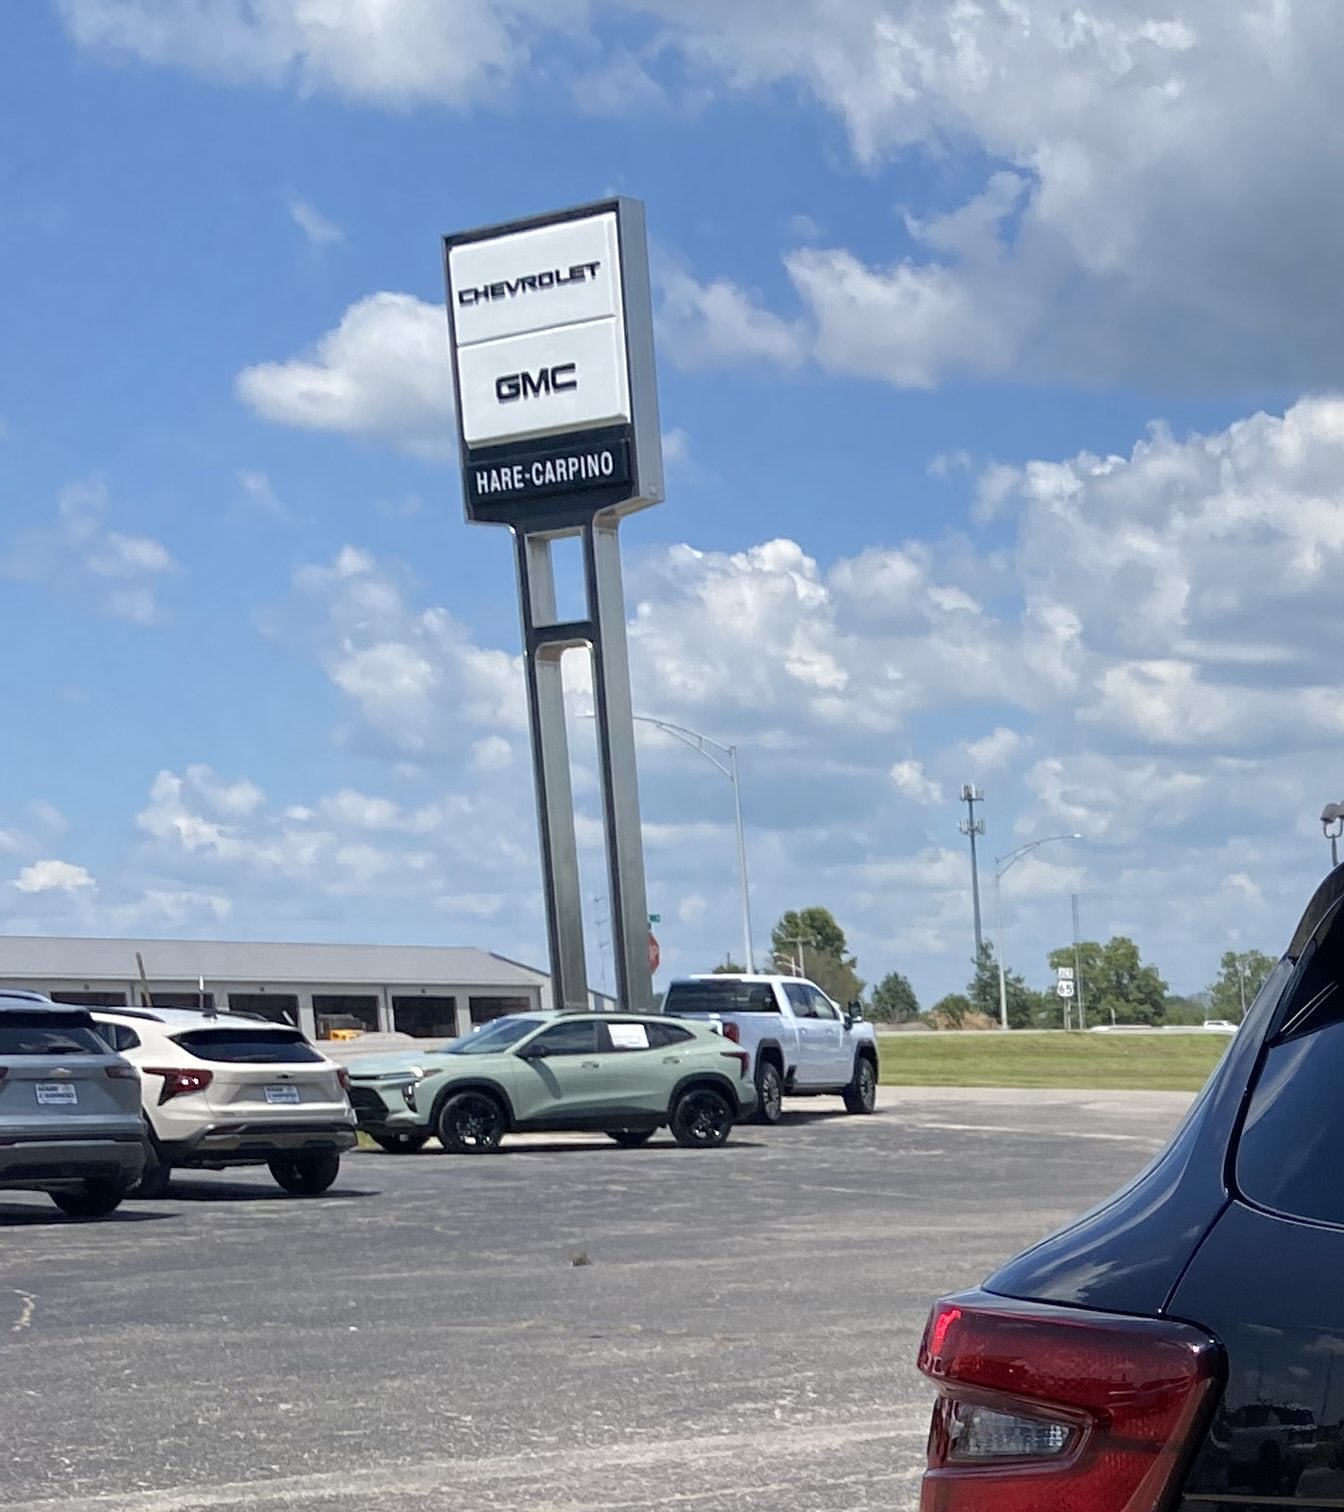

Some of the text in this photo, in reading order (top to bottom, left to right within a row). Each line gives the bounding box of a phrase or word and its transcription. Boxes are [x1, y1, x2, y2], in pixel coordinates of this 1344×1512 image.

[458, 262, 601, 305] CHEVROLET
[496, 362, 577, 403] GMC
[476, 451, 614, 495] HARE-CARPINO
[1059, 984, 1073, 994] 65
